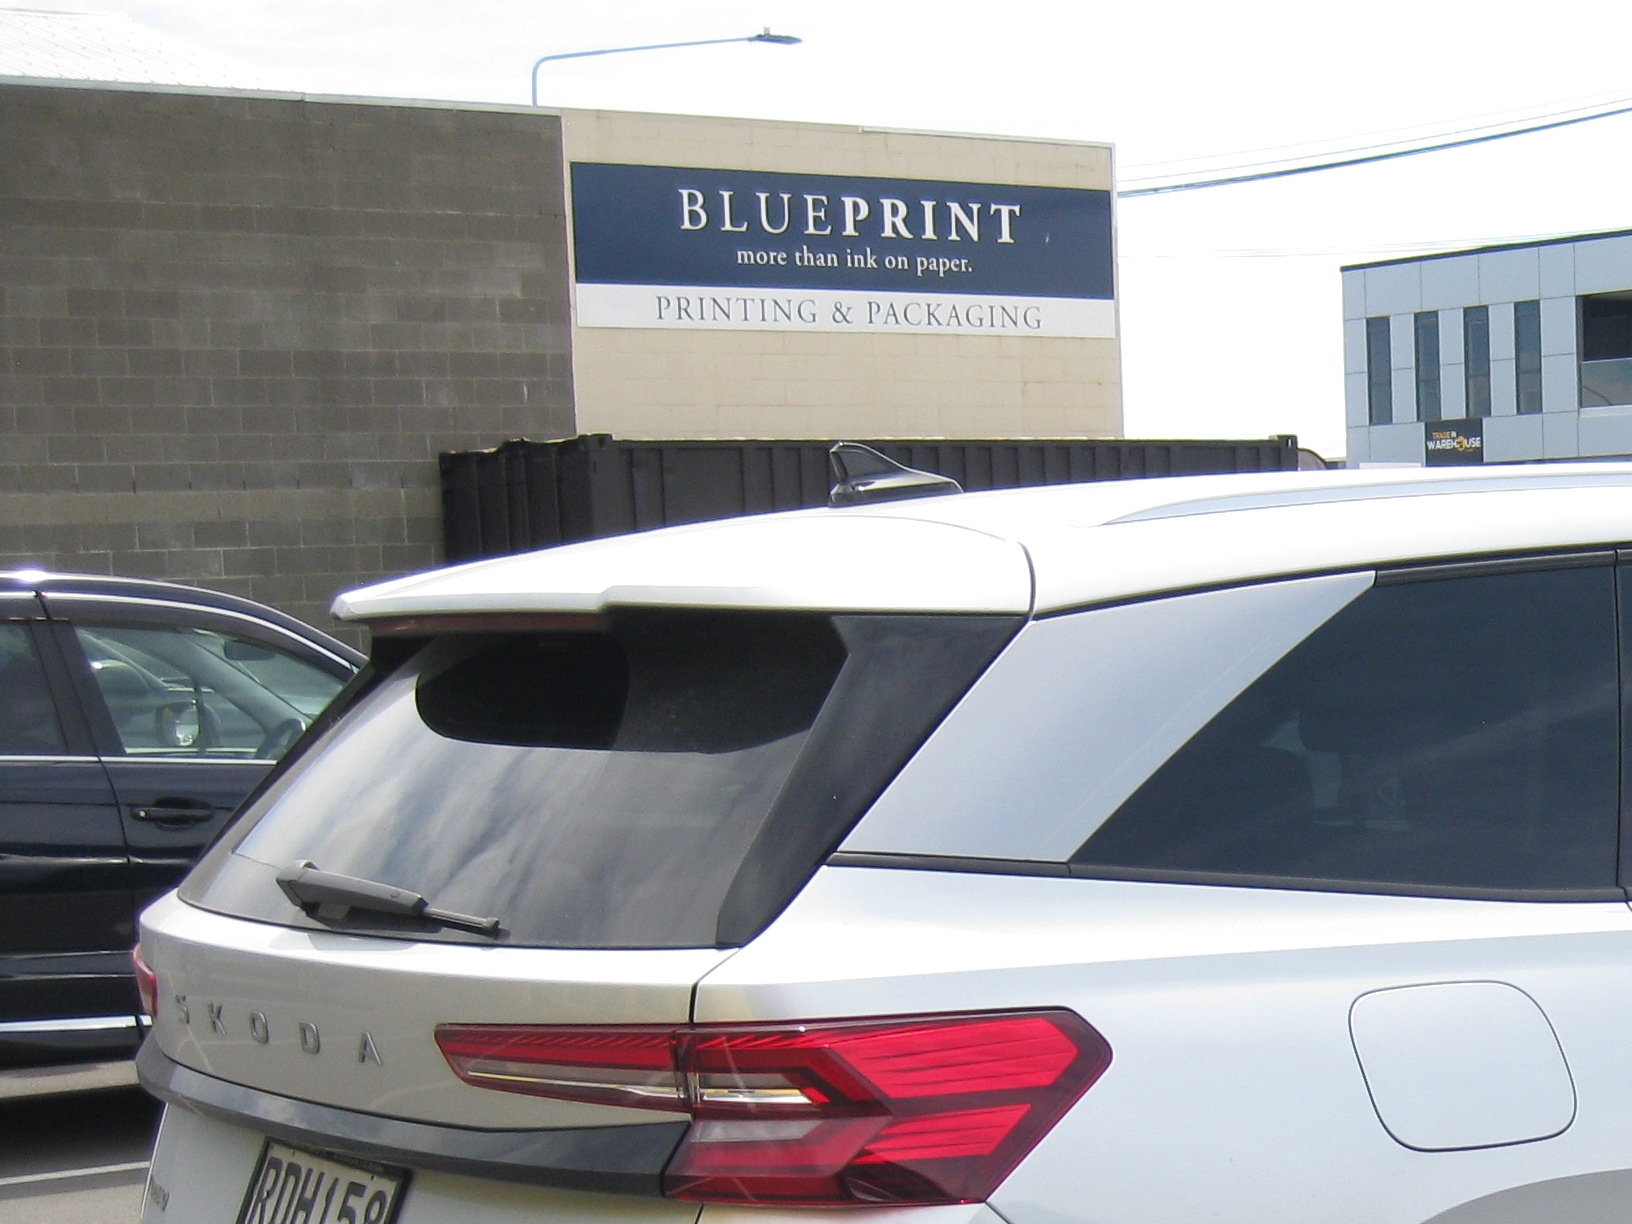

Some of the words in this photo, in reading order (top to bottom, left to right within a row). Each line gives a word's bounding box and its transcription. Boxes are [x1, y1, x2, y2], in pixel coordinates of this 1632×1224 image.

[678, 188, 1021, 244] BLUEPRINT
[737, 250, 788, 265] more
[795, 245, 839, 267] than
[847, 246, 879, 269] ink
[885, 255, 909, 270] on
[917, 255, 973, 278] paper.
[656, 295, 818, 324] PRINTING
[832, 301, 854, 324] &
[867, 301, 1042, 329] PACKAGING
[1427, 436, 1481, 451] WAREHOUSE
